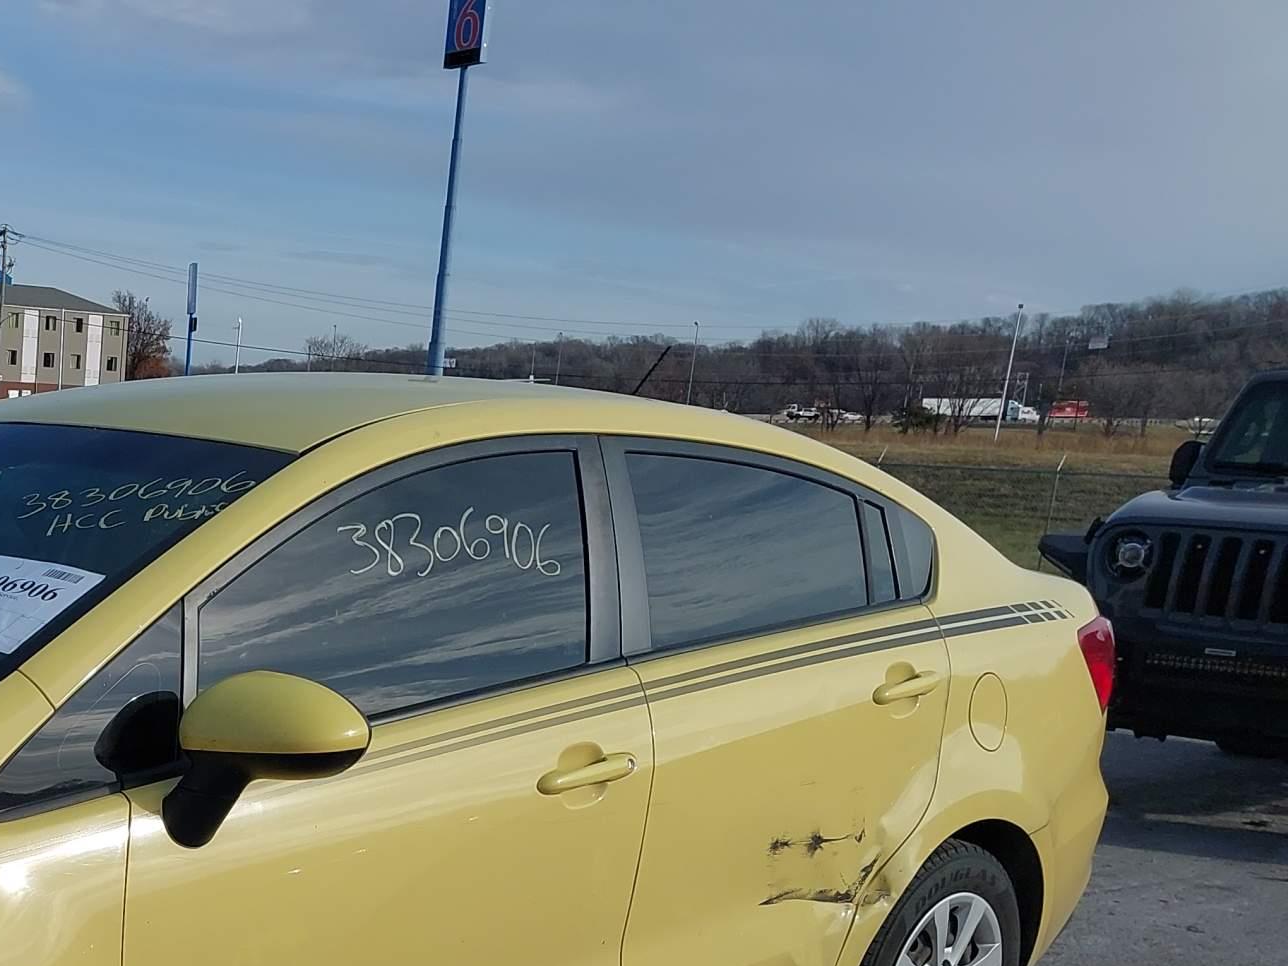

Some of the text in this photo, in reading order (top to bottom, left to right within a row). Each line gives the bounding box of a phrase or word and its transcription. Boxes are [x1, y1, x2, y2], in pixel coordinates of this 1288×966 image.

[455, 0, 480, 51] 6
[17, 470, 256, 519] 38306906
[45, 509, 127, 537] HCC
[336, 507, 561, 577] 38306906
